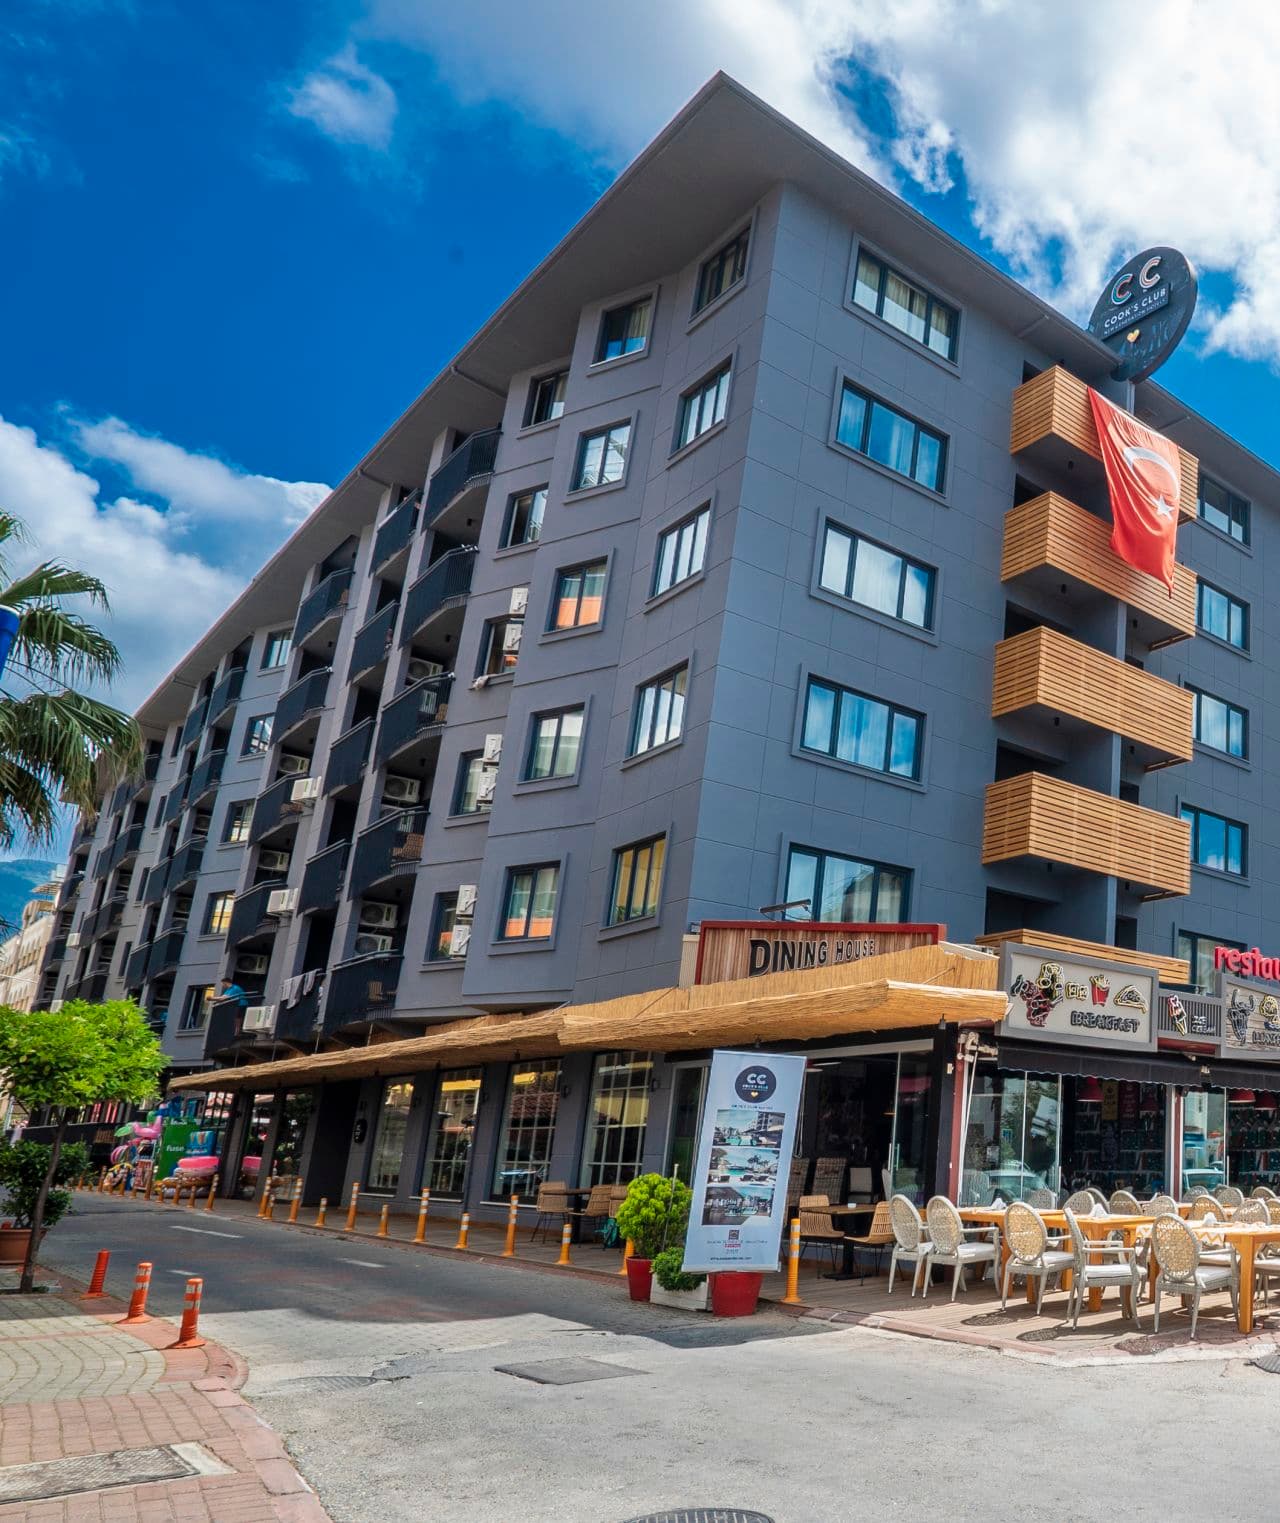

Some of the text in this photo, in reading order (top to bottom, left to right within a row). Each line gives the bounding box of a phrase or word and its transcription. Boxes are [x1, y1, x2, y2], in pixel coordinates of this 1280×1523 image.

[1104, 287, 1166, 328] COOK'S CLUB
[749, 938, 875, 978] DINING HOUSE
